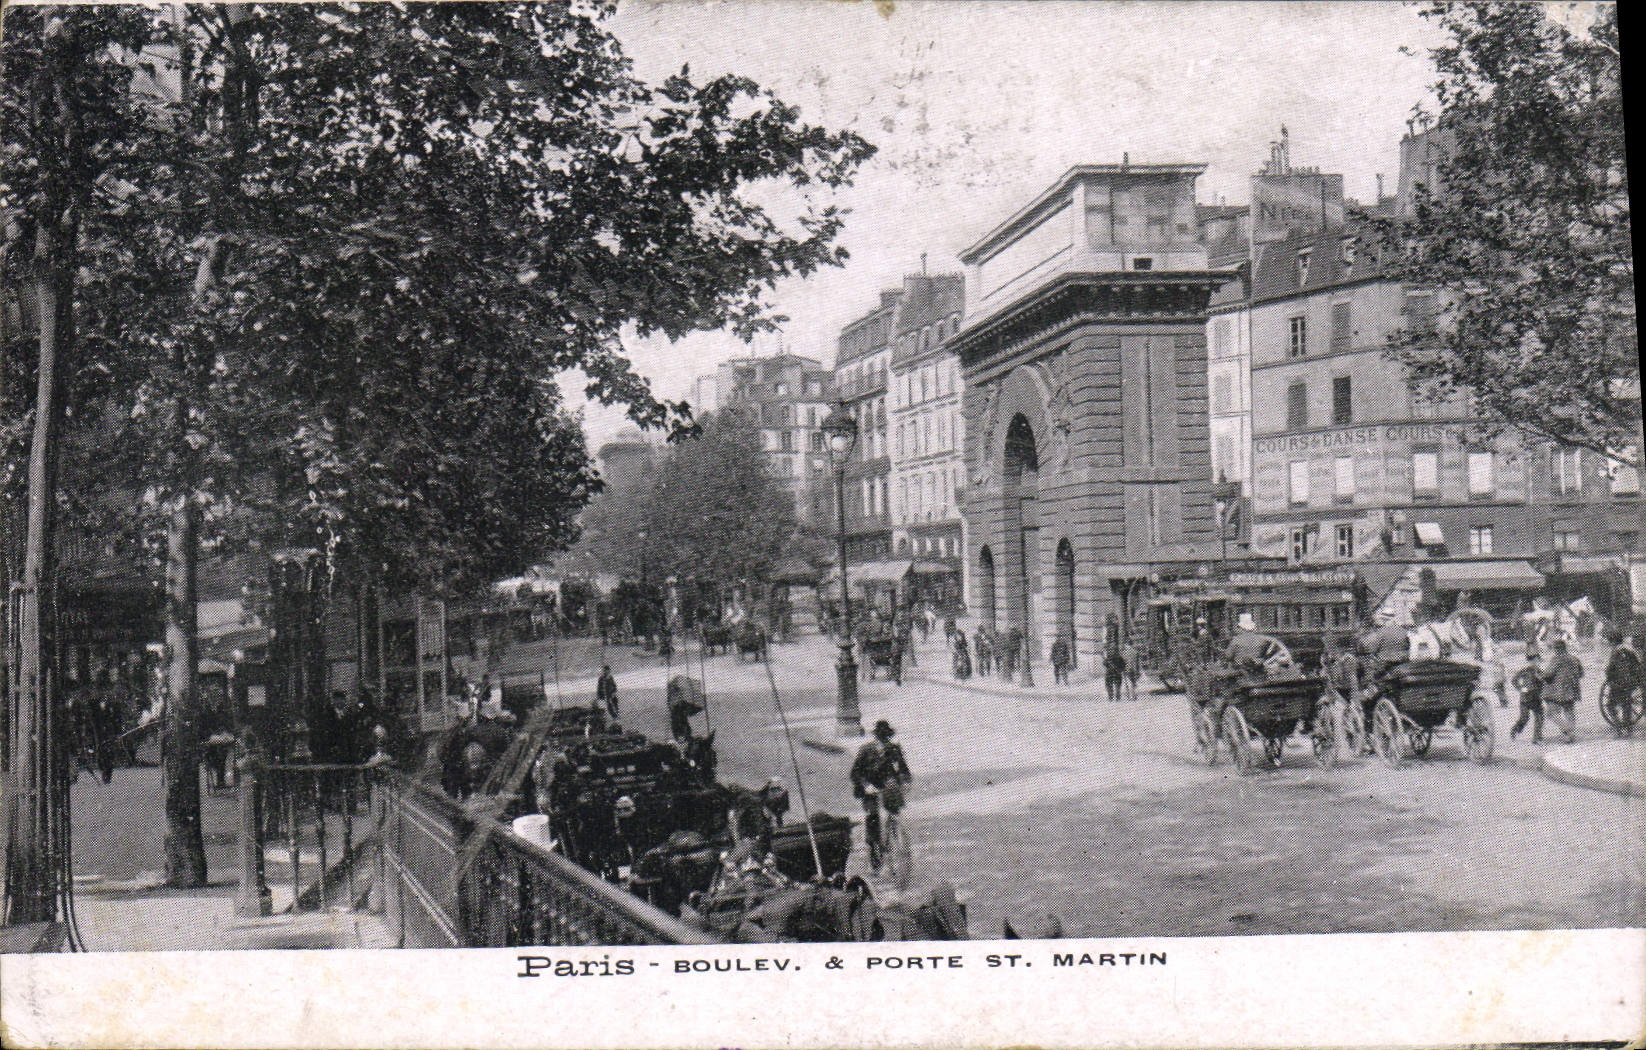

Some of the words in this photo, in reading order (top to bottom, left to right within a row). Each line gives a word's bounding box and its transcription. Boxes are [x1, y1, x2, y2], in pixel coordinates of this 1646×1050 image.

[1255, 434, 1310, 454] COURS
[1322, 428, 1378, 448] DANSE
[1386, 424, 1442, 440] COURS
